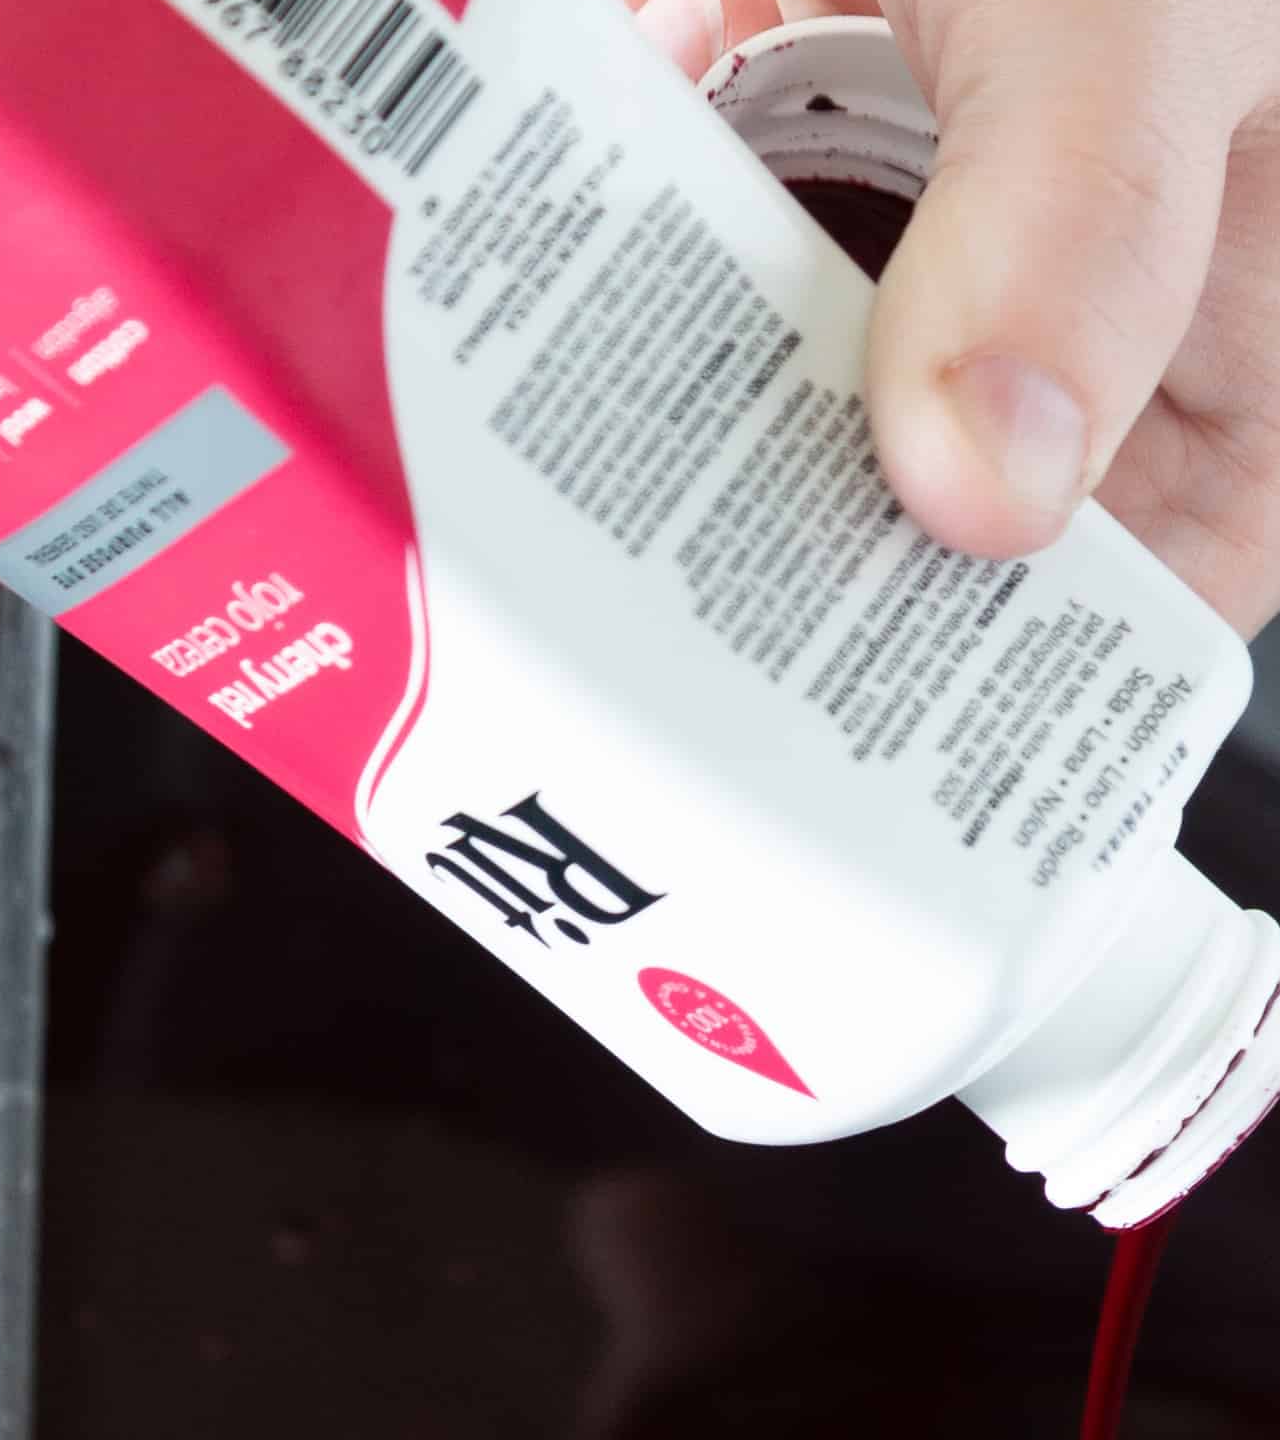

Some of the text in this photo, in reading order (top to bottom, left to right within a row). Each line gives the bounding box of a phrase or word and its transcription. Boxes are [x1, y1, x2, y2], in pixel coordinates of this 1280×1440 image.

[151, 573, 304, 677] rojo cereza
[1092, 618, 1132, 661] Antes
[949, 631, 982, 664] Para
[208, 622, 352, 728] cherry red
[977, 677, 998, 698] de
[1077, 661, 1098, 682] de
[950, 612, 1104, 821] para instrucciones detalladas
[995, 693, 1016, 714] de
[881, 698, 929, 760] grandes
[1020, 721, 1053, 760] visita
[957, 747, 976, 769] de
[1013, 667, 1154, 848] Seda Lana Nylon
[933, 771, 964, 807] 500
[1032, 673, 1192, 888] Algodón Lino Rayón
[962, 761, 1024, 848] ritdye.com
[426, 790, 669, 949] Rit
[686, 1005, 728, 1040] 100
